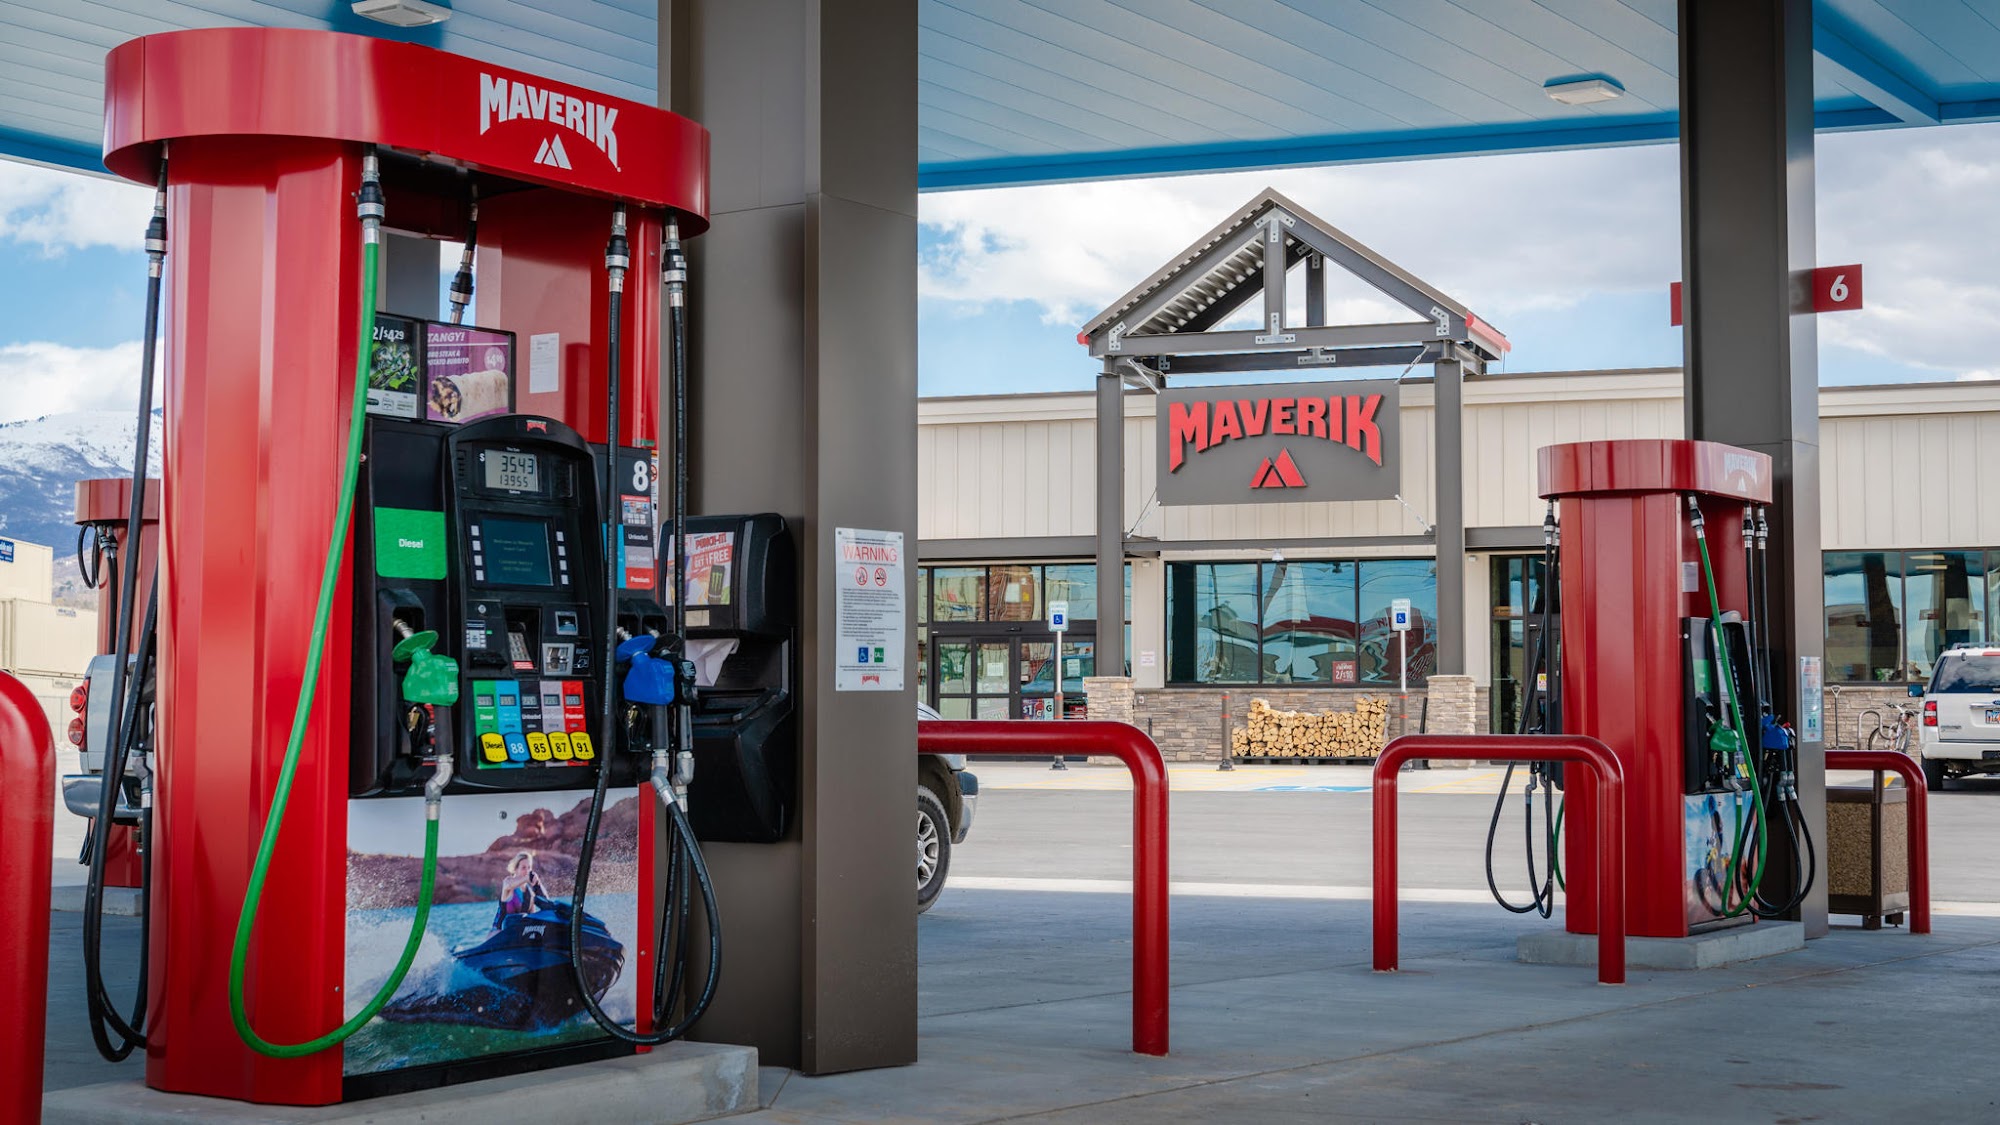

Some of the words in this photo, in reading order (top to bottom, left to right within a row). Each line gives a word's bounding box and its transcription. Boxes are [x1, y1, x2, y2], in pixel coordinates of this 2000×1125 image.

[480, 72, 619, 169] MAVERIK
[1830, 275, 1848, 302] 6
[427, 332, 465, 343] TANGY!
[1169, 393, 1383, 473] MAVERIK
[632, 460, 649, 492] 8
[1724, 453, 1757, 485] MAVERIK
[399, 538, 424, 548] Diesel
[709, 548, 728, 566] FREE
[843, 546, 897, 563] WARNING
[510, 742, 525, 754] 88
[534, 743, 546, 754] 85
[556, 742, 566, 752] 87
[576, 742, 589, 752] 91
